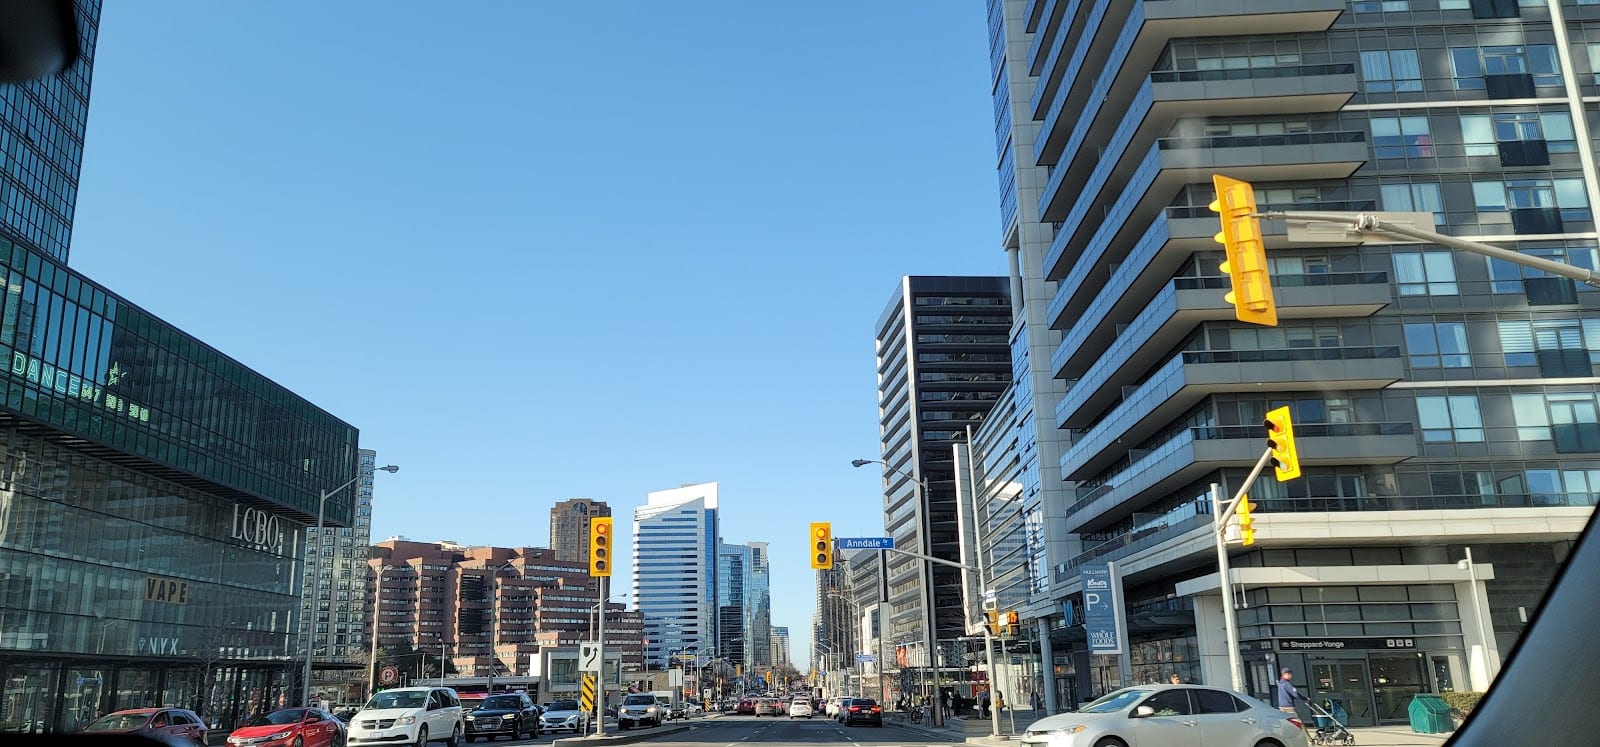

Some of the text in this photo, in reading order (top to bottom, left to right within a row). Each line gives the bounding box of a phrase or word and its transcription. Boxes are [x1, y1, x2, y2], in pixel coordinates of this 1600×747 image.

[12, 351, 80, 398] DANCE
[231, 503, 279, 549] LCBO
[846, 539, 881, 548] Anndale
[147, 578, 188, 603] VAPE
[1086, 593, 1100, 612] P
[1090, 631, 1114, 639] WHOLE
[1290, 641, 1345, 649] Sheppard-Yonge
